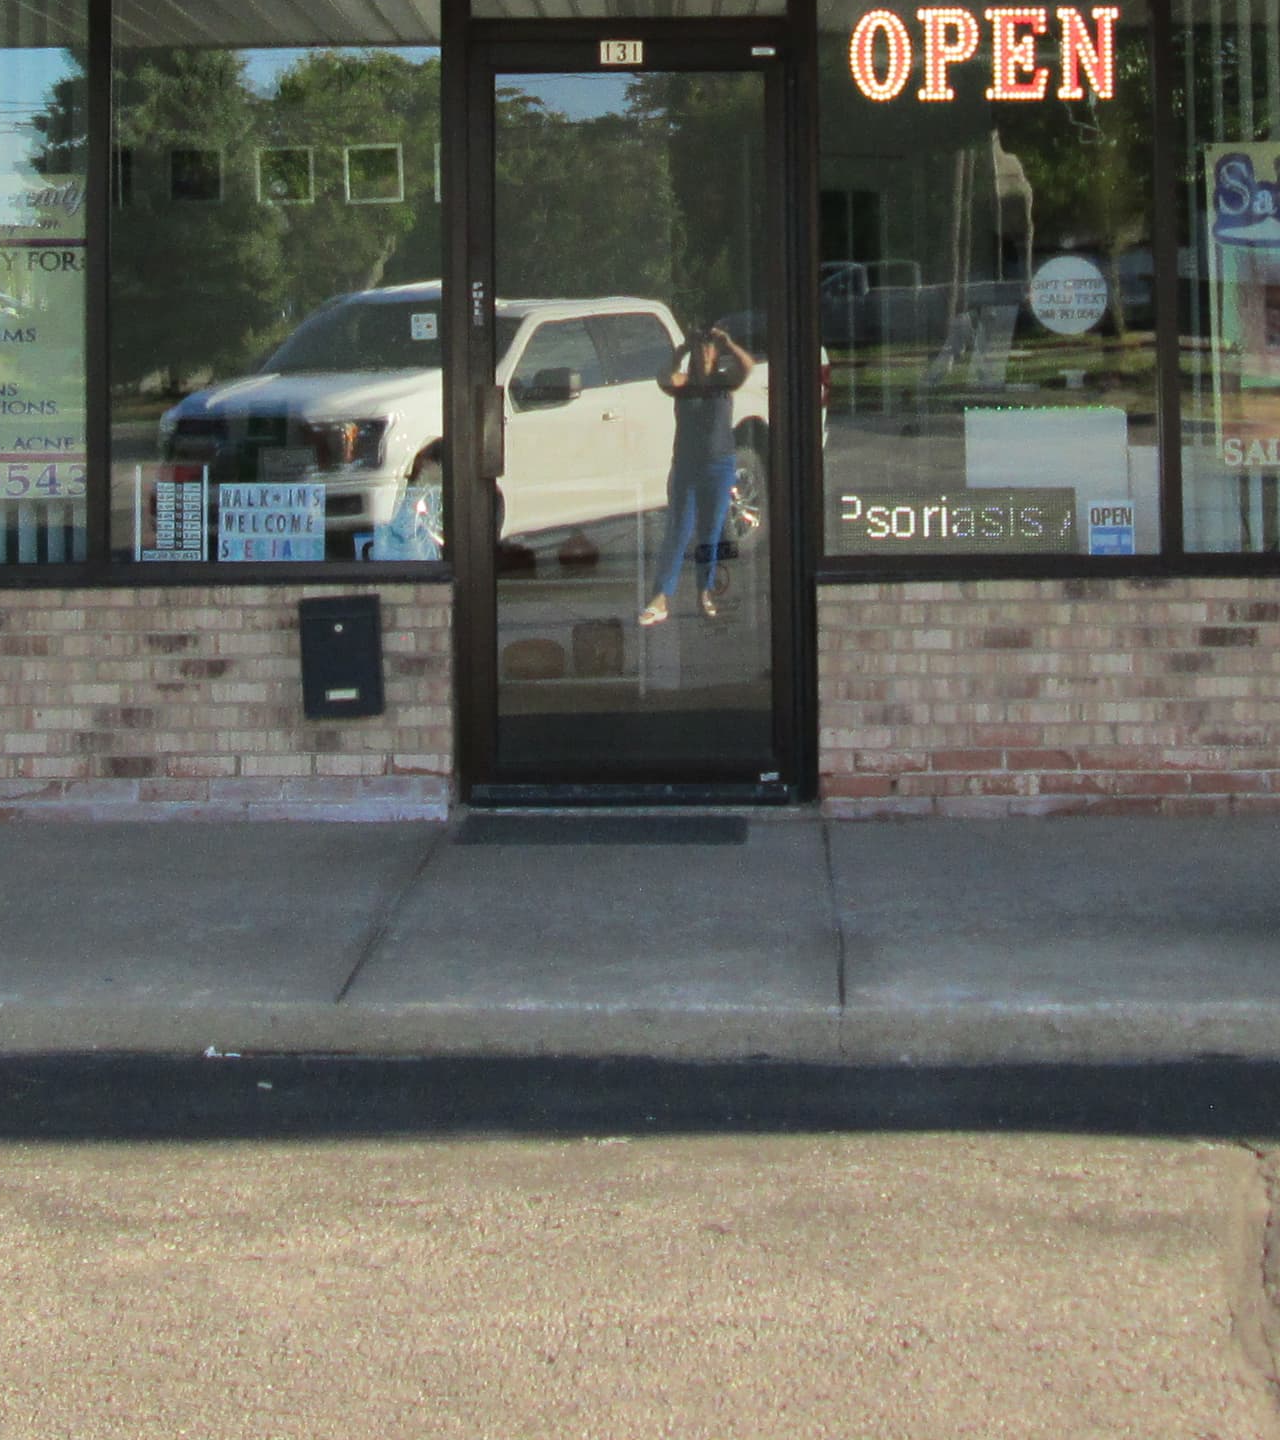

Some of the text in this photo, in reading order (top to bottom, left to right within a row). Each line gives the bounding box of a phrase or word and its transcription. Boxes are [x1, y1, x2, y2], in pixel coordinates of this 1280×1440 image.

[604, 42, 638, 62] 131
[849, 6, 1119, 101] OPEN
[13, 436, 75, 451] ACNE
[223, 513, 315, 534] WELCOME
[1090, 507, 1132, 526] OPEN
